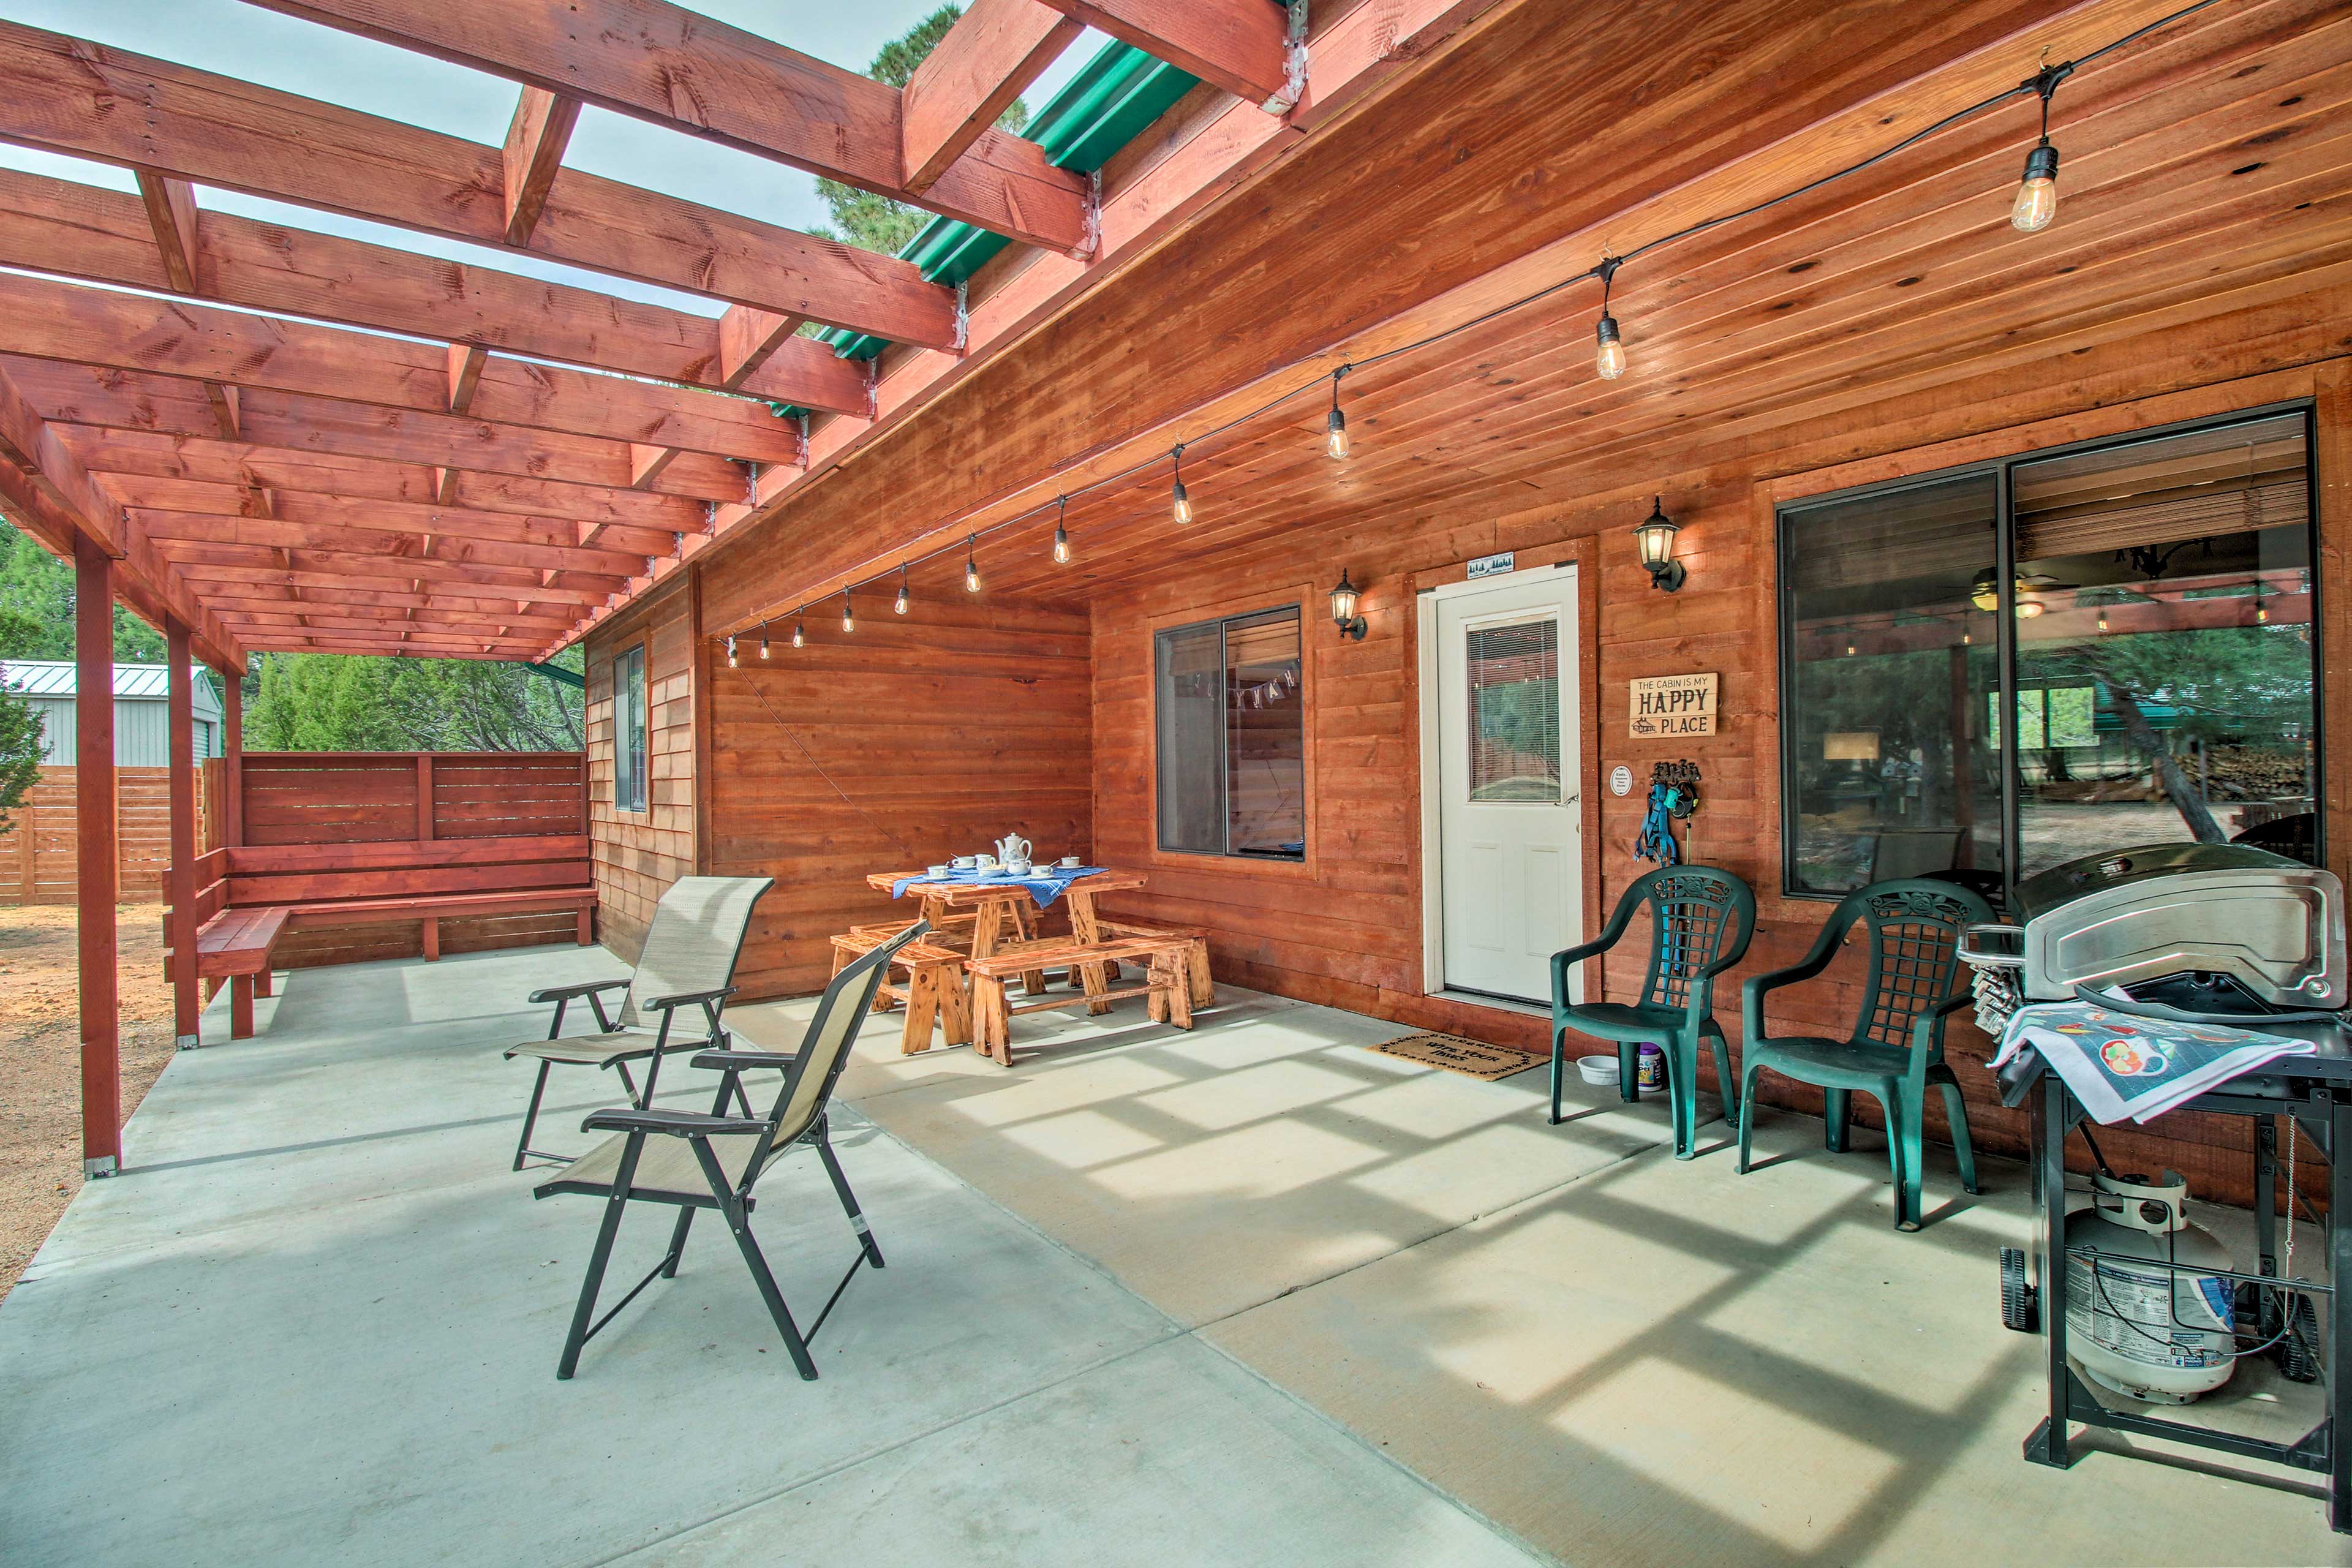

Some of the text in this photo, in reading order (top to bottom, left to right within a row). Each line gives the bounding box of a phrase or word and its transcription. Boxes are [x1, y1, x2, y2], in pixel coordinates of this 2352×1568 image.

[1638, 680, 1654, 690] THE
[1656, 679, 1681, 688] CABIN
[1694, 677, 1708, 686] MY
[1638, 688, 1708, 714] HAPPY
[1660, 717, 1708, 734] PLACE
[1426, 1042, 1499, 1061] WIPE YOUR
[1429, 1050, 1469, 1061] PAWS
